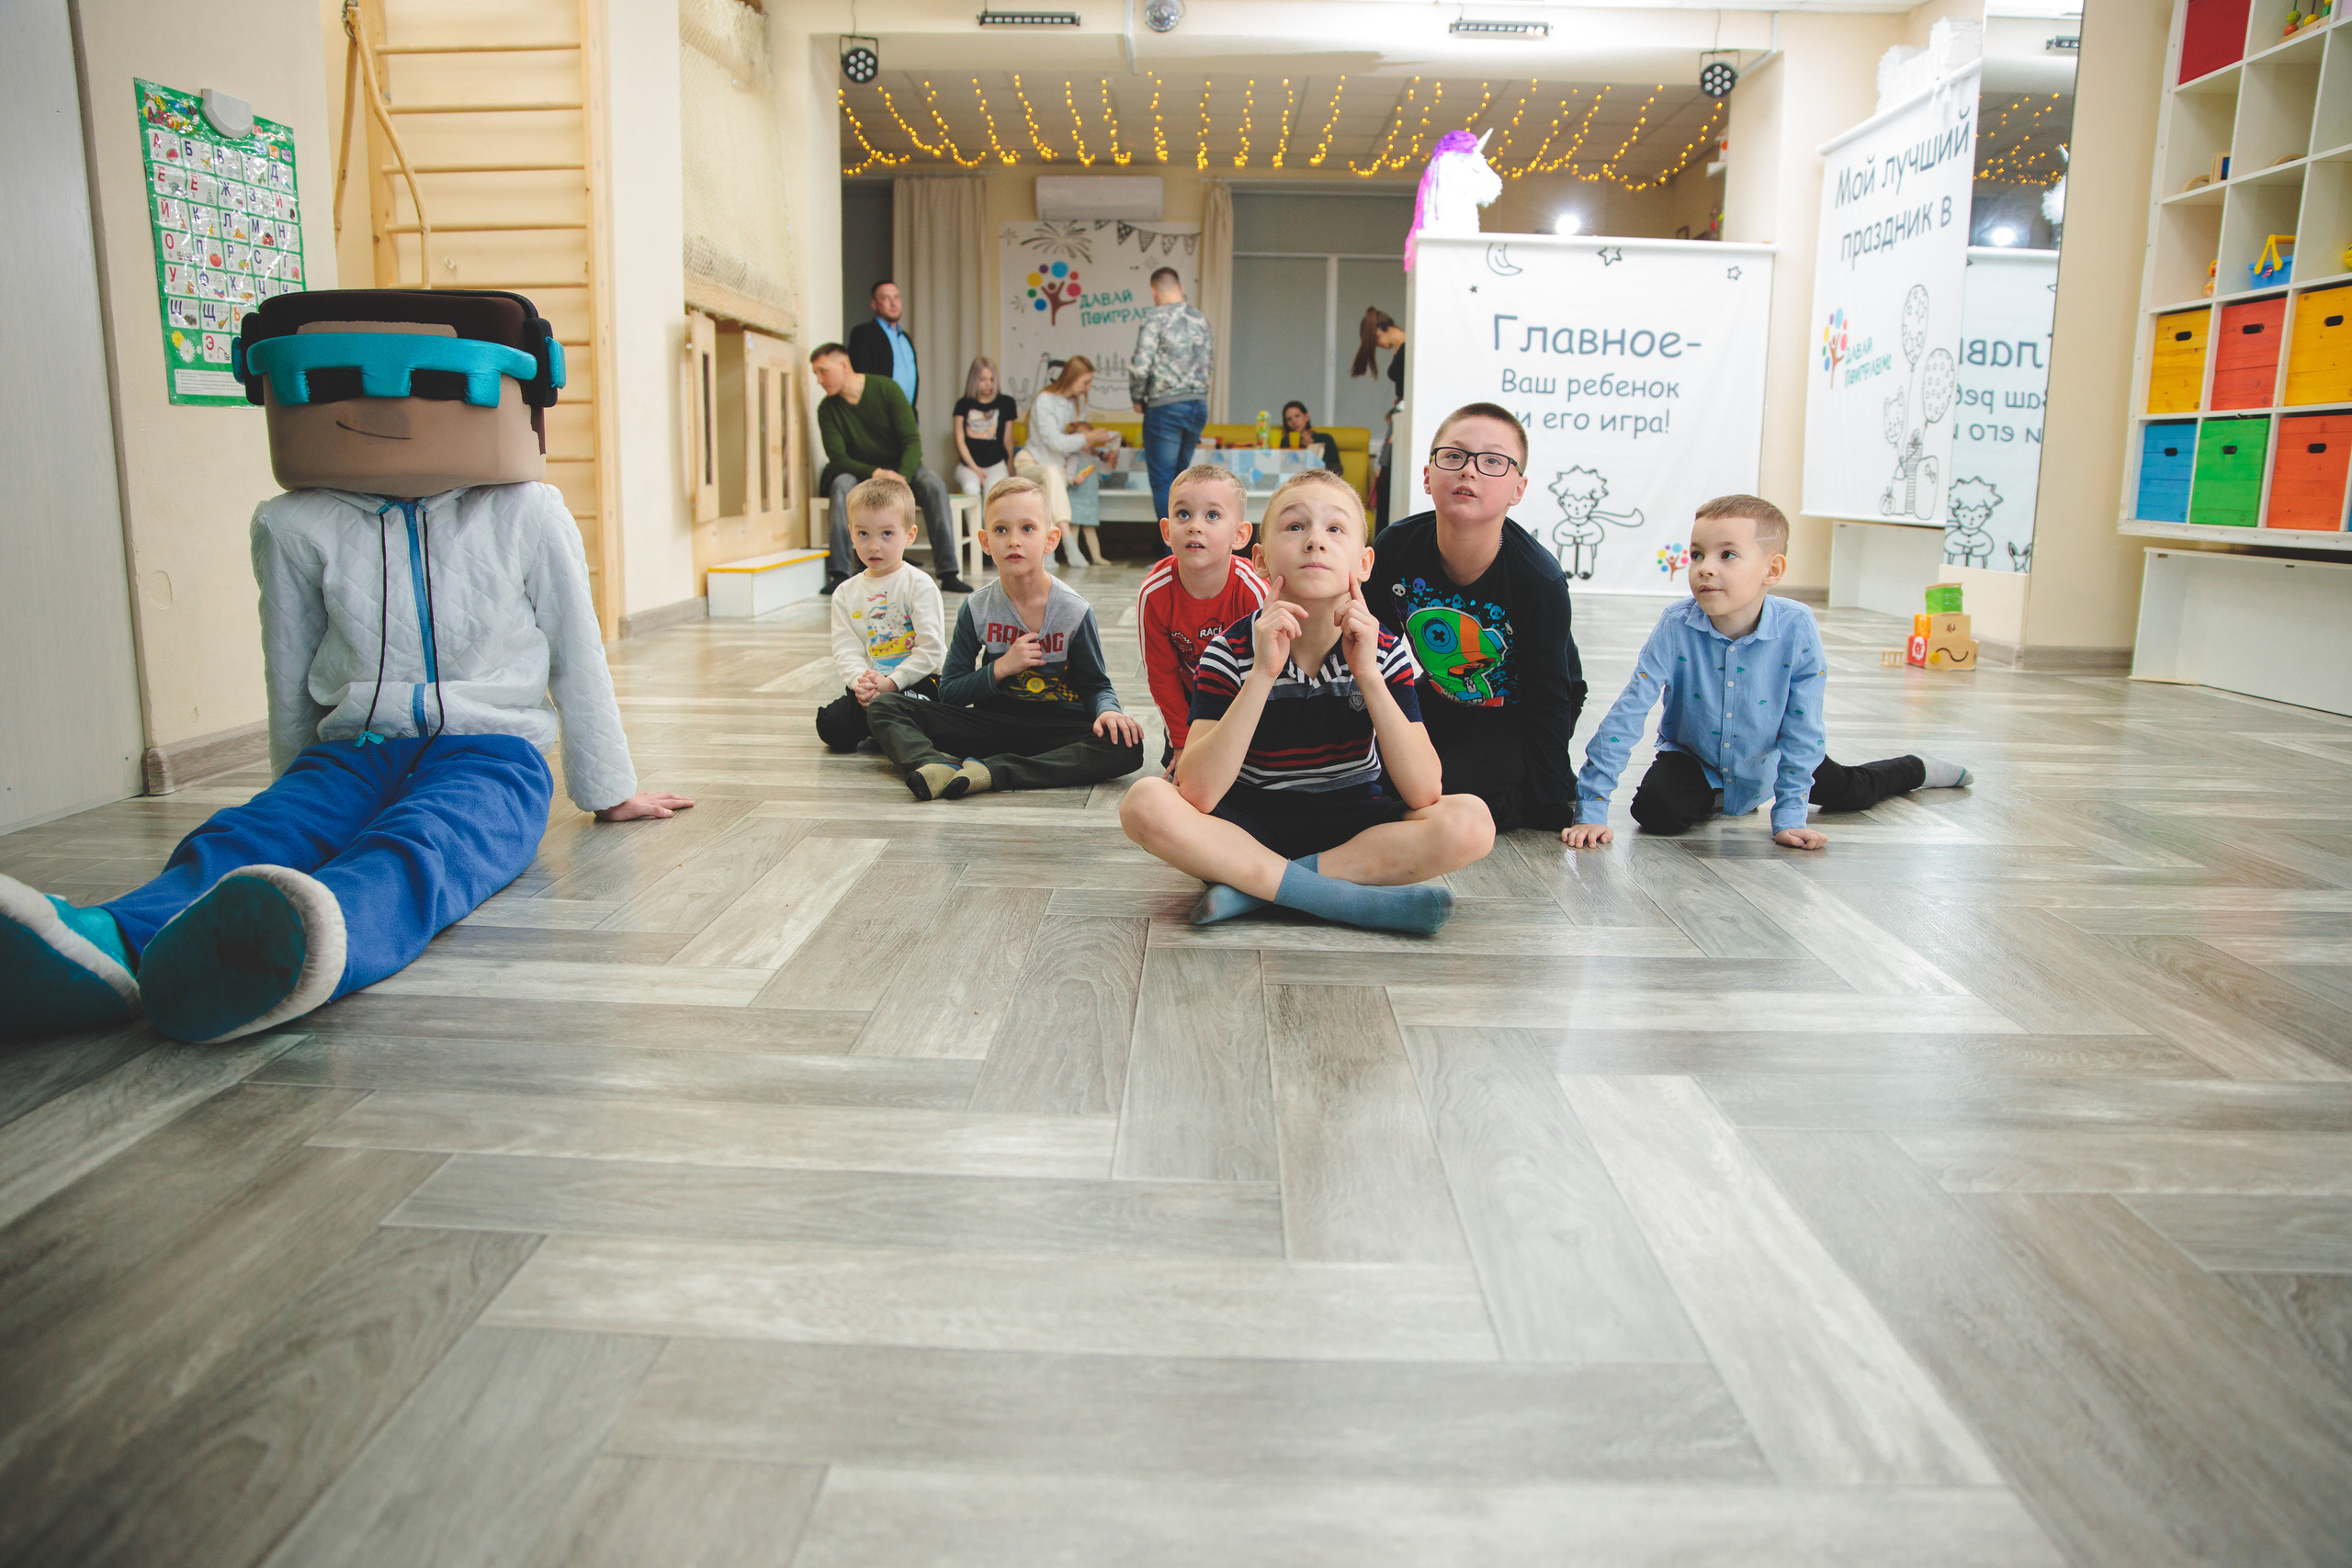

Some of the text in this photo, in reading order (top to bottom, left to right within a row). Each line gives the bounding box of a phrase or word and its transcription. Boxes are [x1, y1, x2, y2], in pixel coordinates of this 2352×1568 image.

[184, 141, 193, 157] Б
[270, 164, 279, 182] Д
[1836, 106, 1970, 209] Мой лучший
[249, 187, 256, 202] З
[161, 197, 170, 218] Й
[223, 213, 232, 228] Л
[251, 219, 260, 233] М
[277, 224, 286, 238] Н
[196, 239, 204, 254] П
[1841, 201, 1933, 271] праздник
[170, 299, 183, 316] Ш
[203, 303, 216, 321] Щ
[1079, 288, 1133, 309] ДАВАЙ
[205, 335, 215, 351] Э
[1502, 368, 1679, 402] Ваш ребенок
[1516, 409, 1670, 439] и его игра!
[987, 622, 1065, 653] RANG
